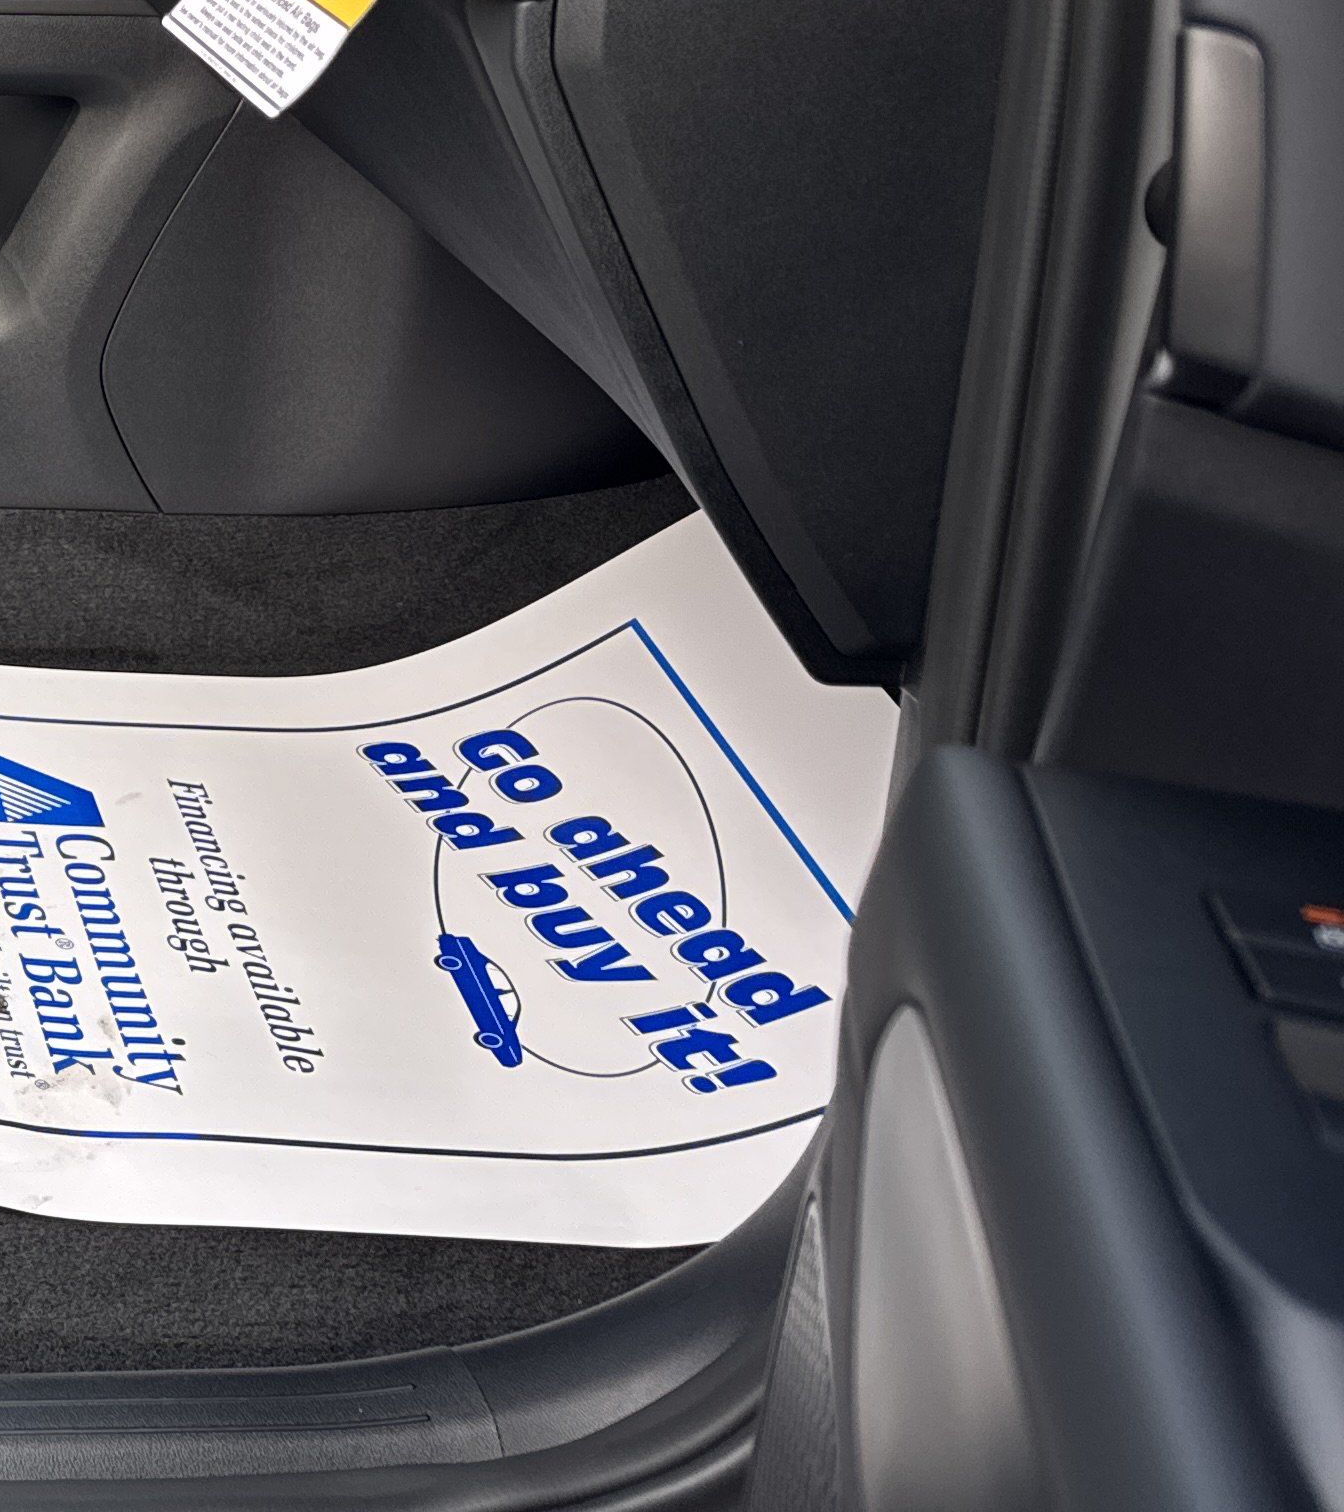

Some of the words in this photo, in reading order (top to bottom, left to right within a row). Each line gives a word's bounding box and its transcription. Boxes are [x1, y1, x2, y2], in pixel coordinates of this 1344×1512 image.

[290, 4, 304, 19] Air
[298, 12, 322, 35] Bags
[55, 833, 185, 1095] Community
[148, 857, 230, 973] through
[167, 778, 248, 916] Financing
[227, 922, 324, 1074] available
[356, 742, 526, 851] and
[477, 862, 659, 982] buy
[620, 1001, 777, 1094] it!
[453, 729, 563, 804] Go
[544, 816, 833, 1027] ahead
[19, 952, 115, 1075] Bank
